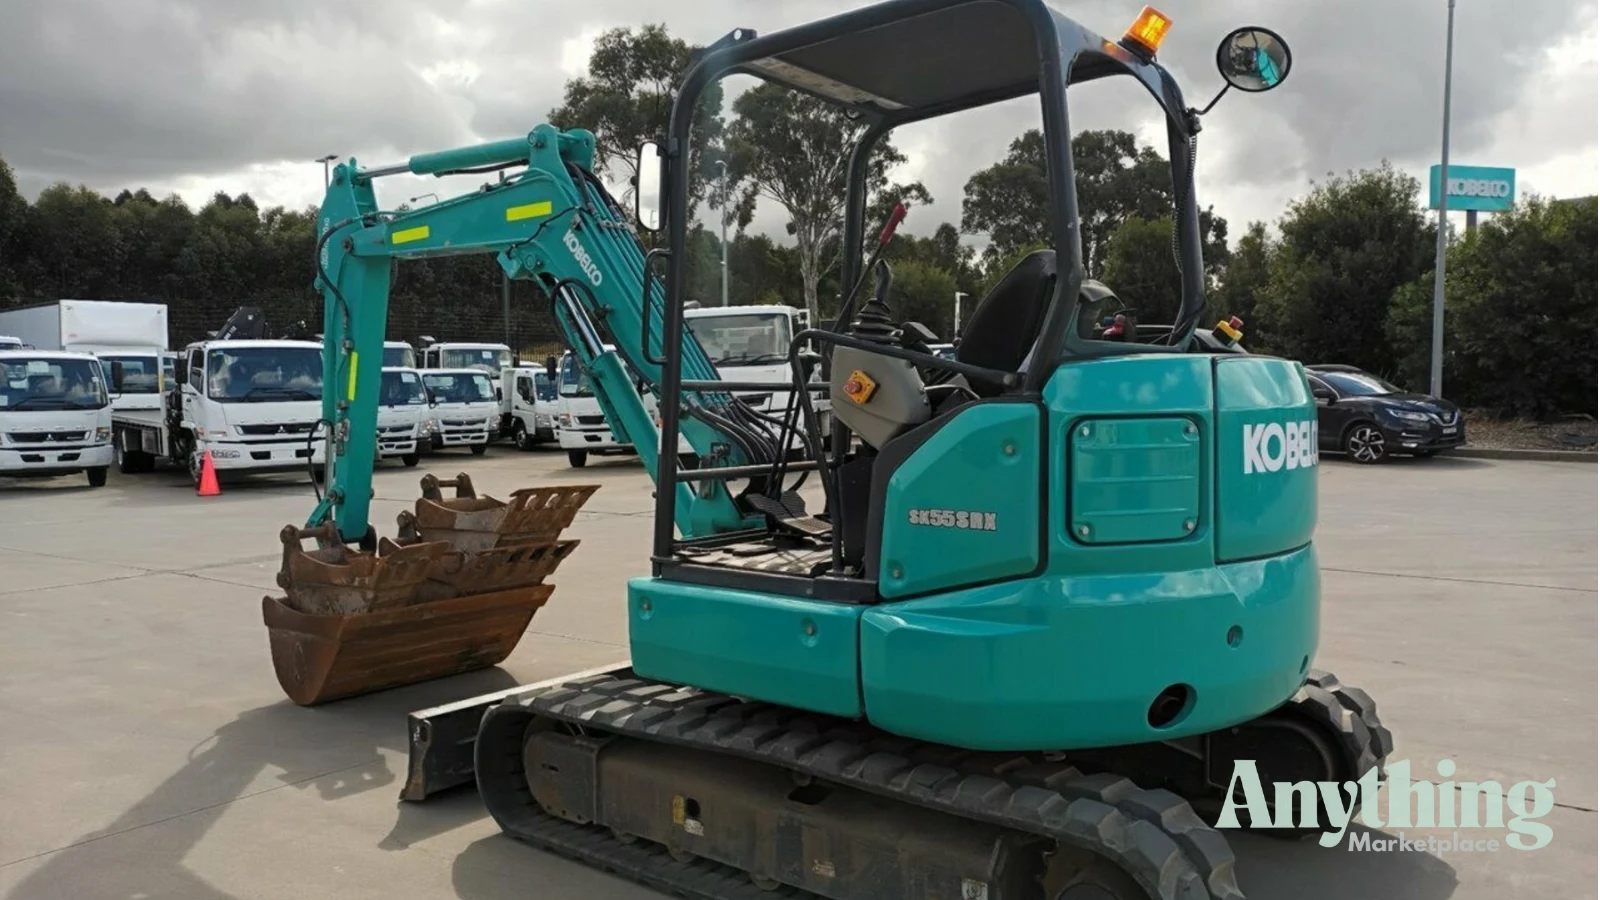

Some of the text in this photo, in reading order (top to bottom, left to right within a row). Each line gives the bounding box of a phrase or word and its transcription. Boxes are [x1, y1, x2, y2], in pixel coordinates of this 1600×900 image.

[1446, 178, 1510, 198] KOBELCO
[562, 228, 603, 287] KOBELCO
[908, 509, 997, 531] SK55SRX
